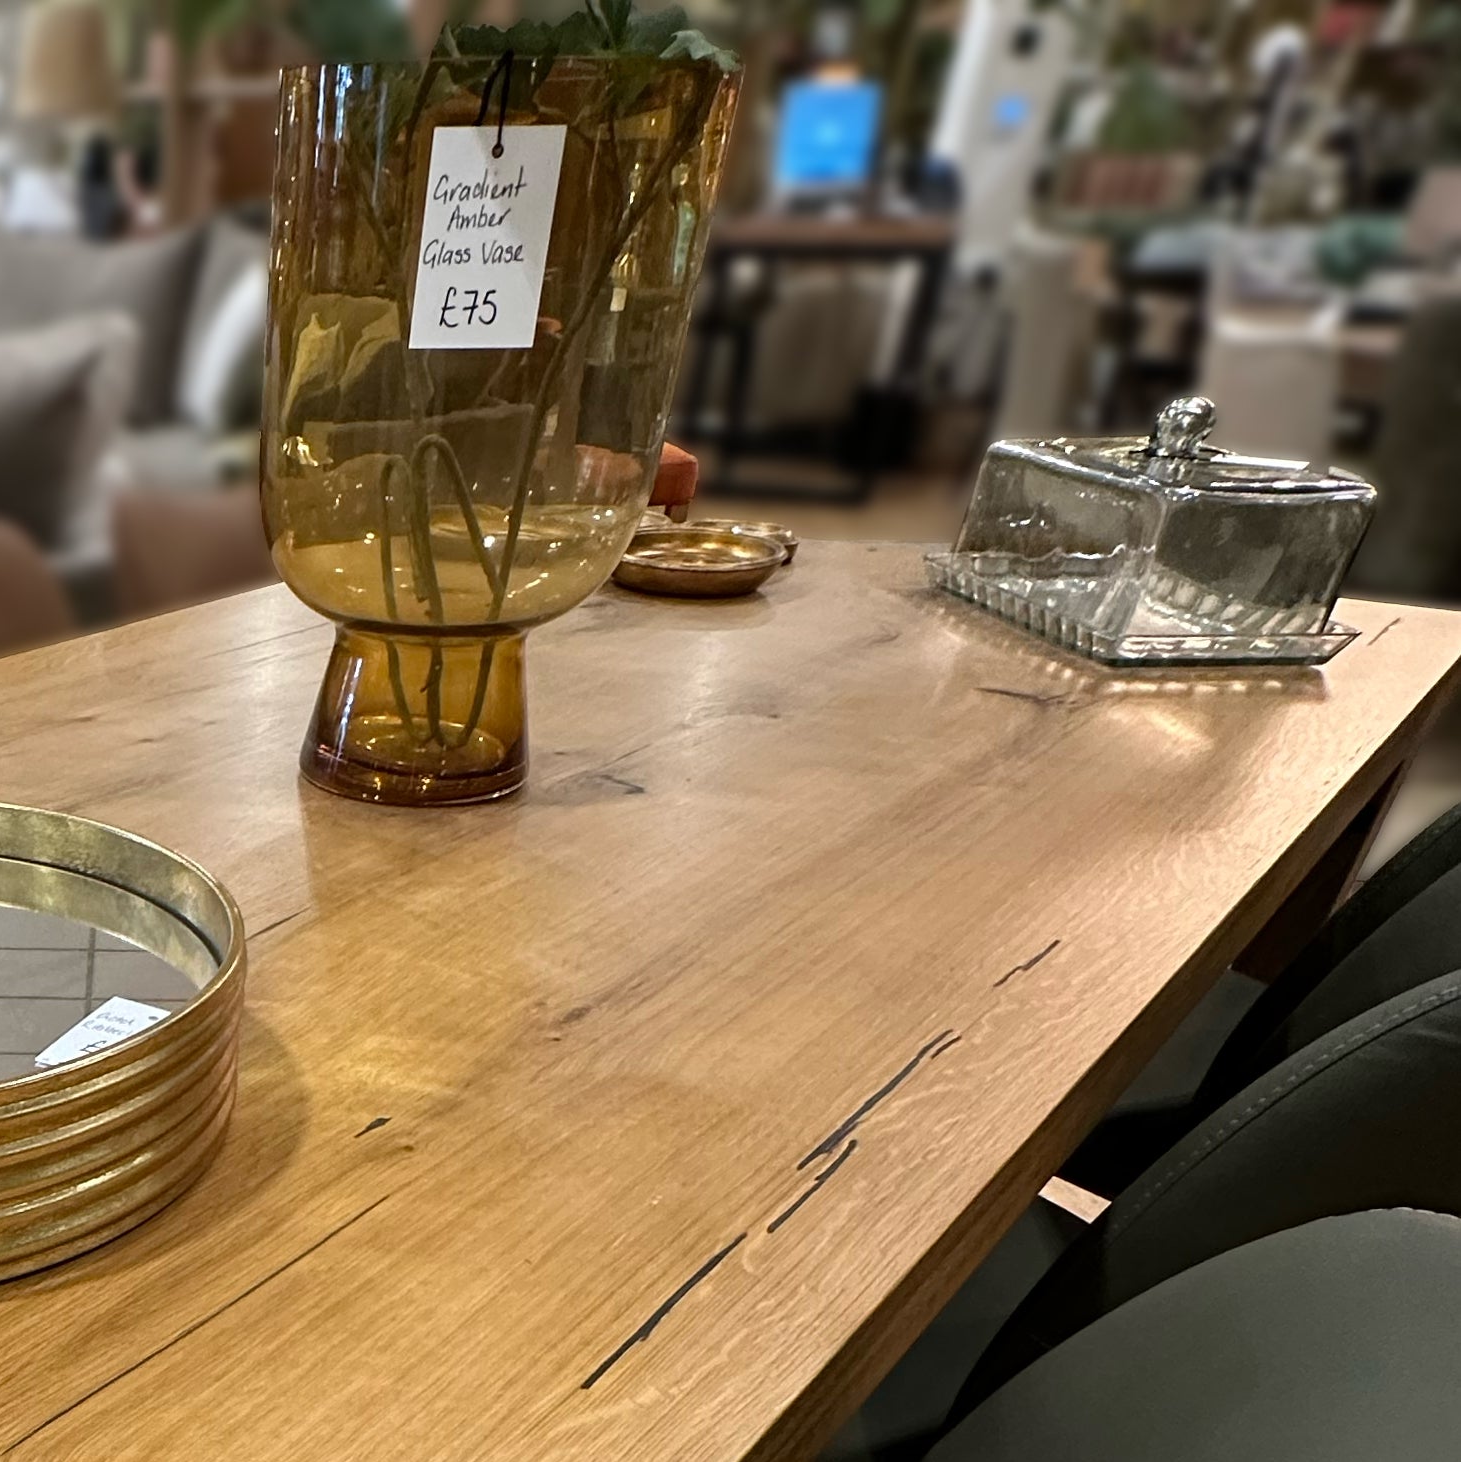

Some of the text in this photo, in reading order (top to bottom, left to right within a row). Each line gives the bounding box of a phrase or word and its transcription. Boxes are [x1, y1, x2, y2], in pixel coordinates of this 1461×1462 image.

[433, 165, 528, 205] Gradient
[446, 203, 512, 232] Amber
[422, 238, 524, 270] Glass Vase
[439, 286, 498, 328] £75
